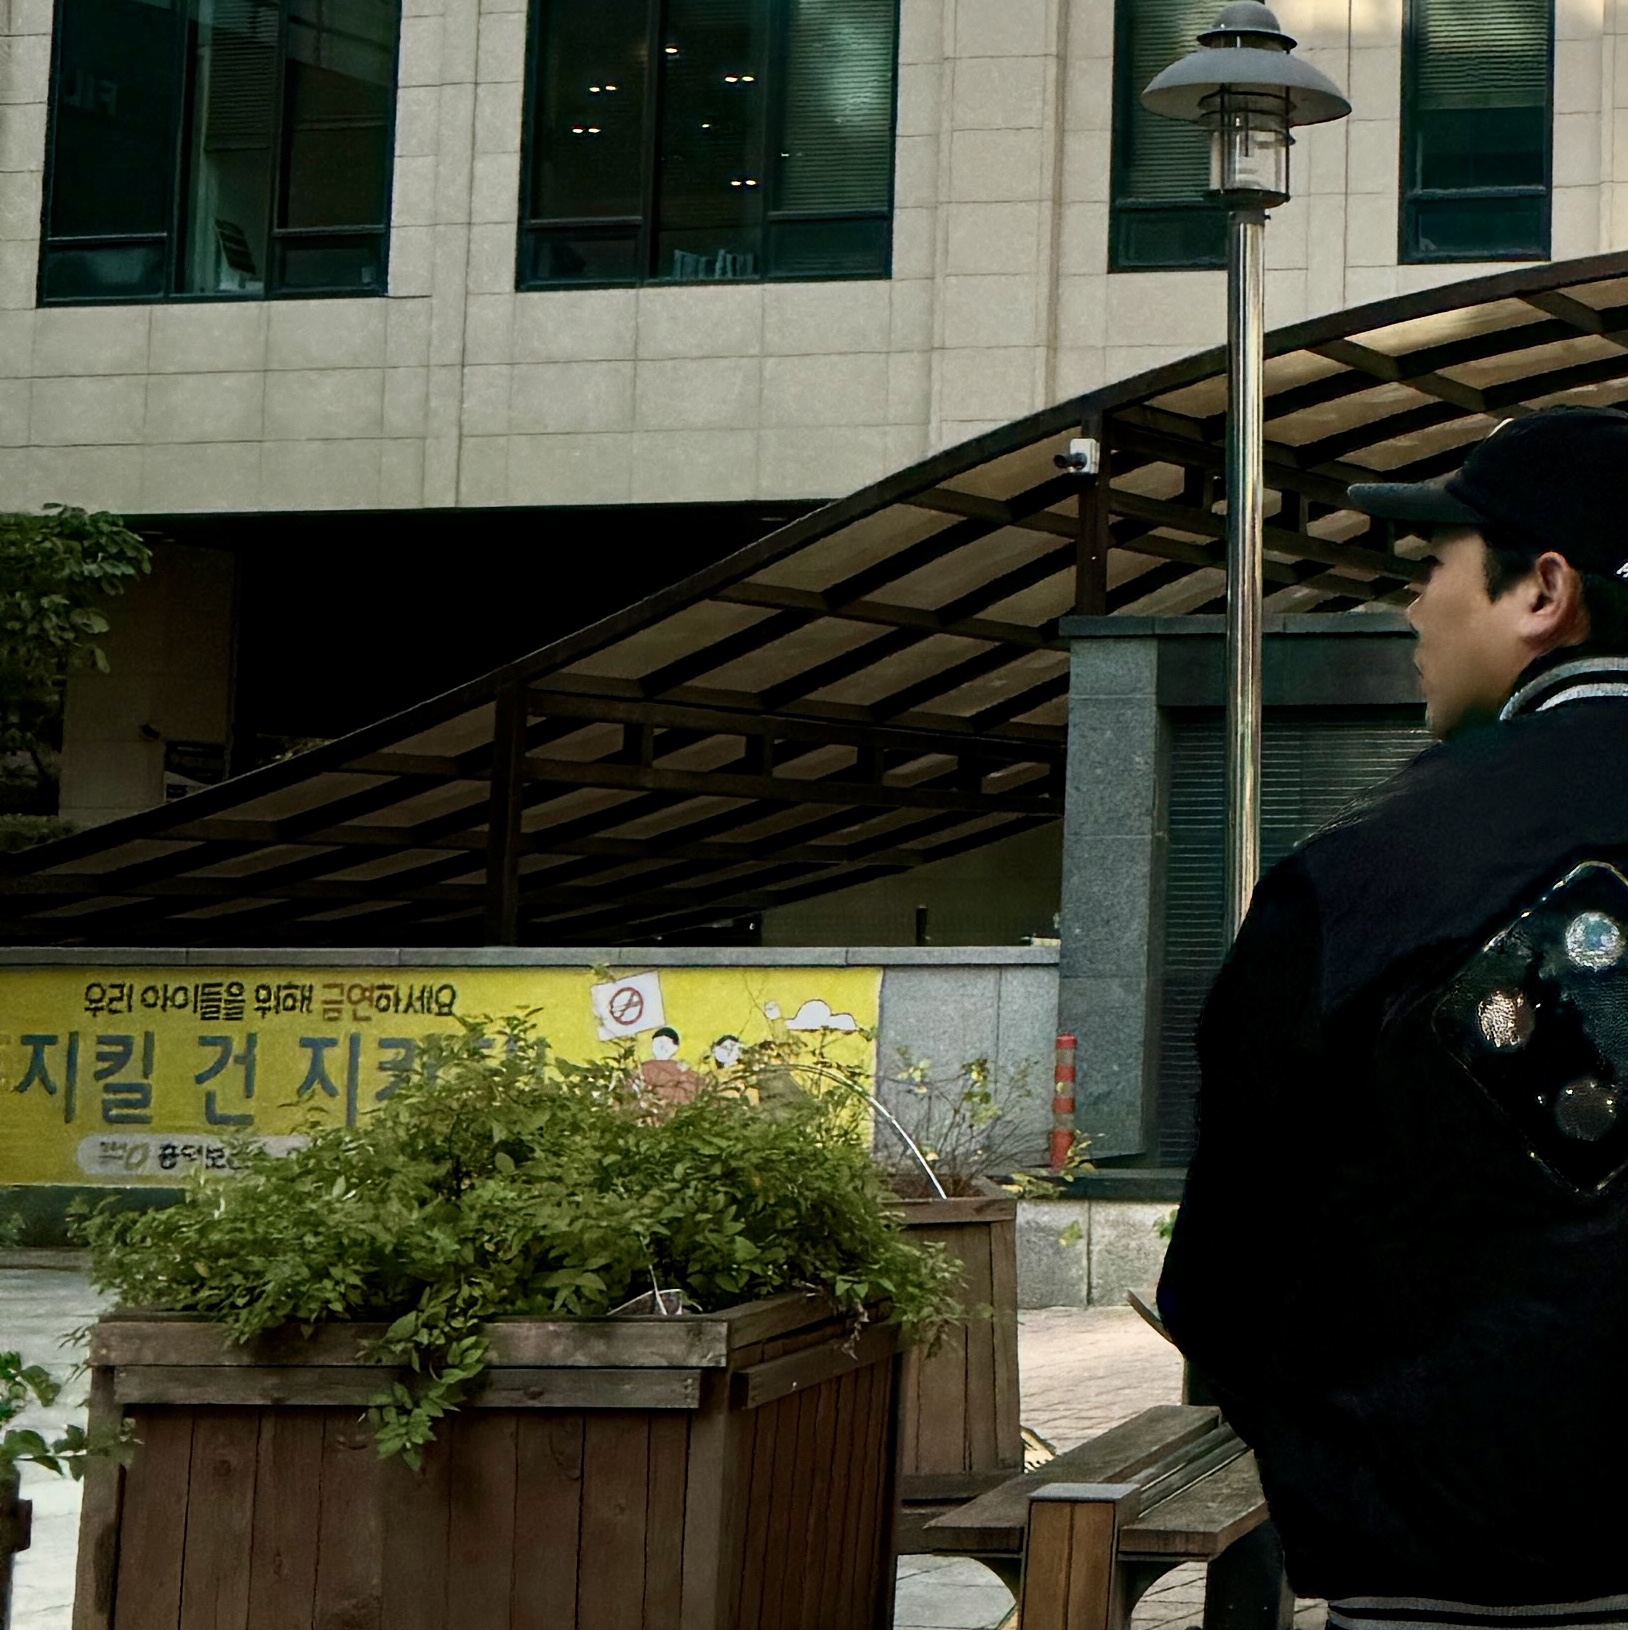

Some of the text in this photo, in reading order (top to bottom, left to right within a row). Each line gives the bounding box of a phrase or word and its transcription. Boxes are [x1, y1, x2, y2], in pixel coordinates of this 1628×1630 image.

[84, 981, 459, 1023] 우리 아이들을 위해 금연하세요
[17, 1030, 155, 1125] 지킬
[194, 1031, 259, 1126] 건
